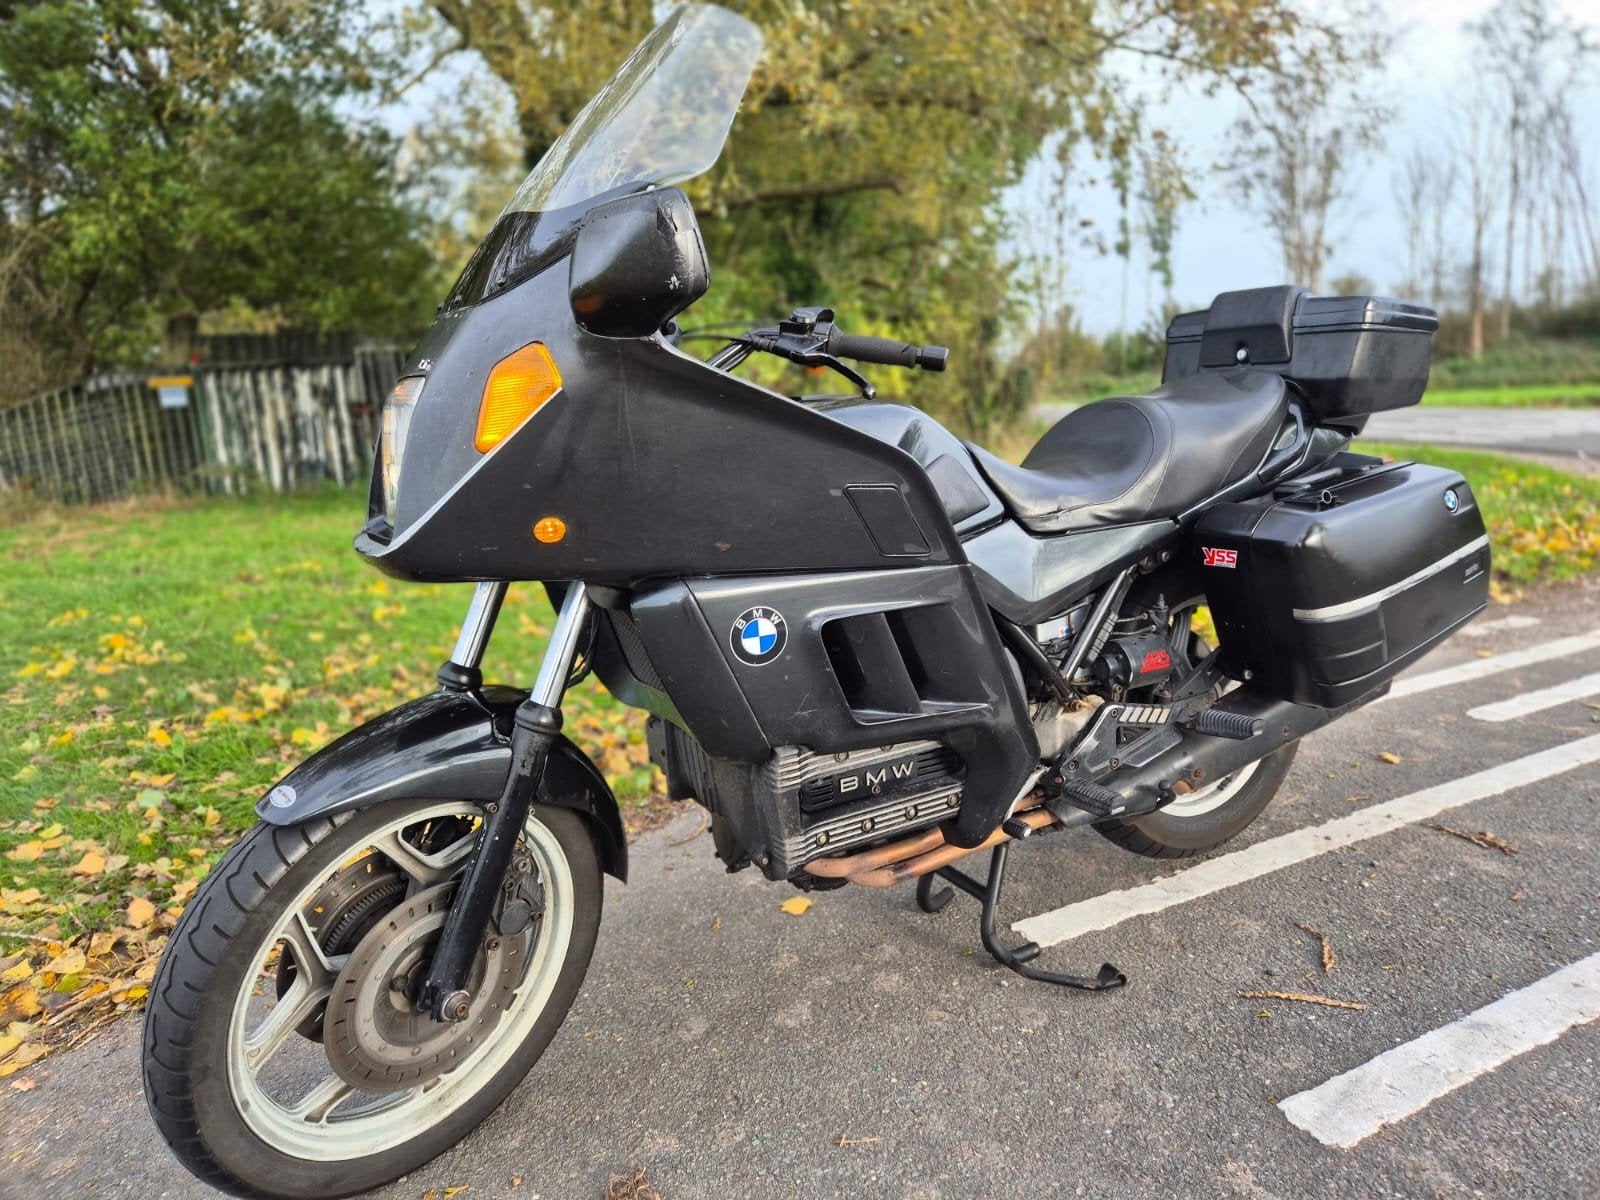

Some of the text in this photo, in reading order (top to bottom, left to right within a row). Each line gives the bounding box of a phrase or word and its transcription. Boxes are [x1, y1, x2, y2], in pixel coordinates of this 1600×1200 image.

[1202, 547, 1238, 567] YSS
[736, 608, 782, 630] BMW
[840, 761, 914, 793] BMW
